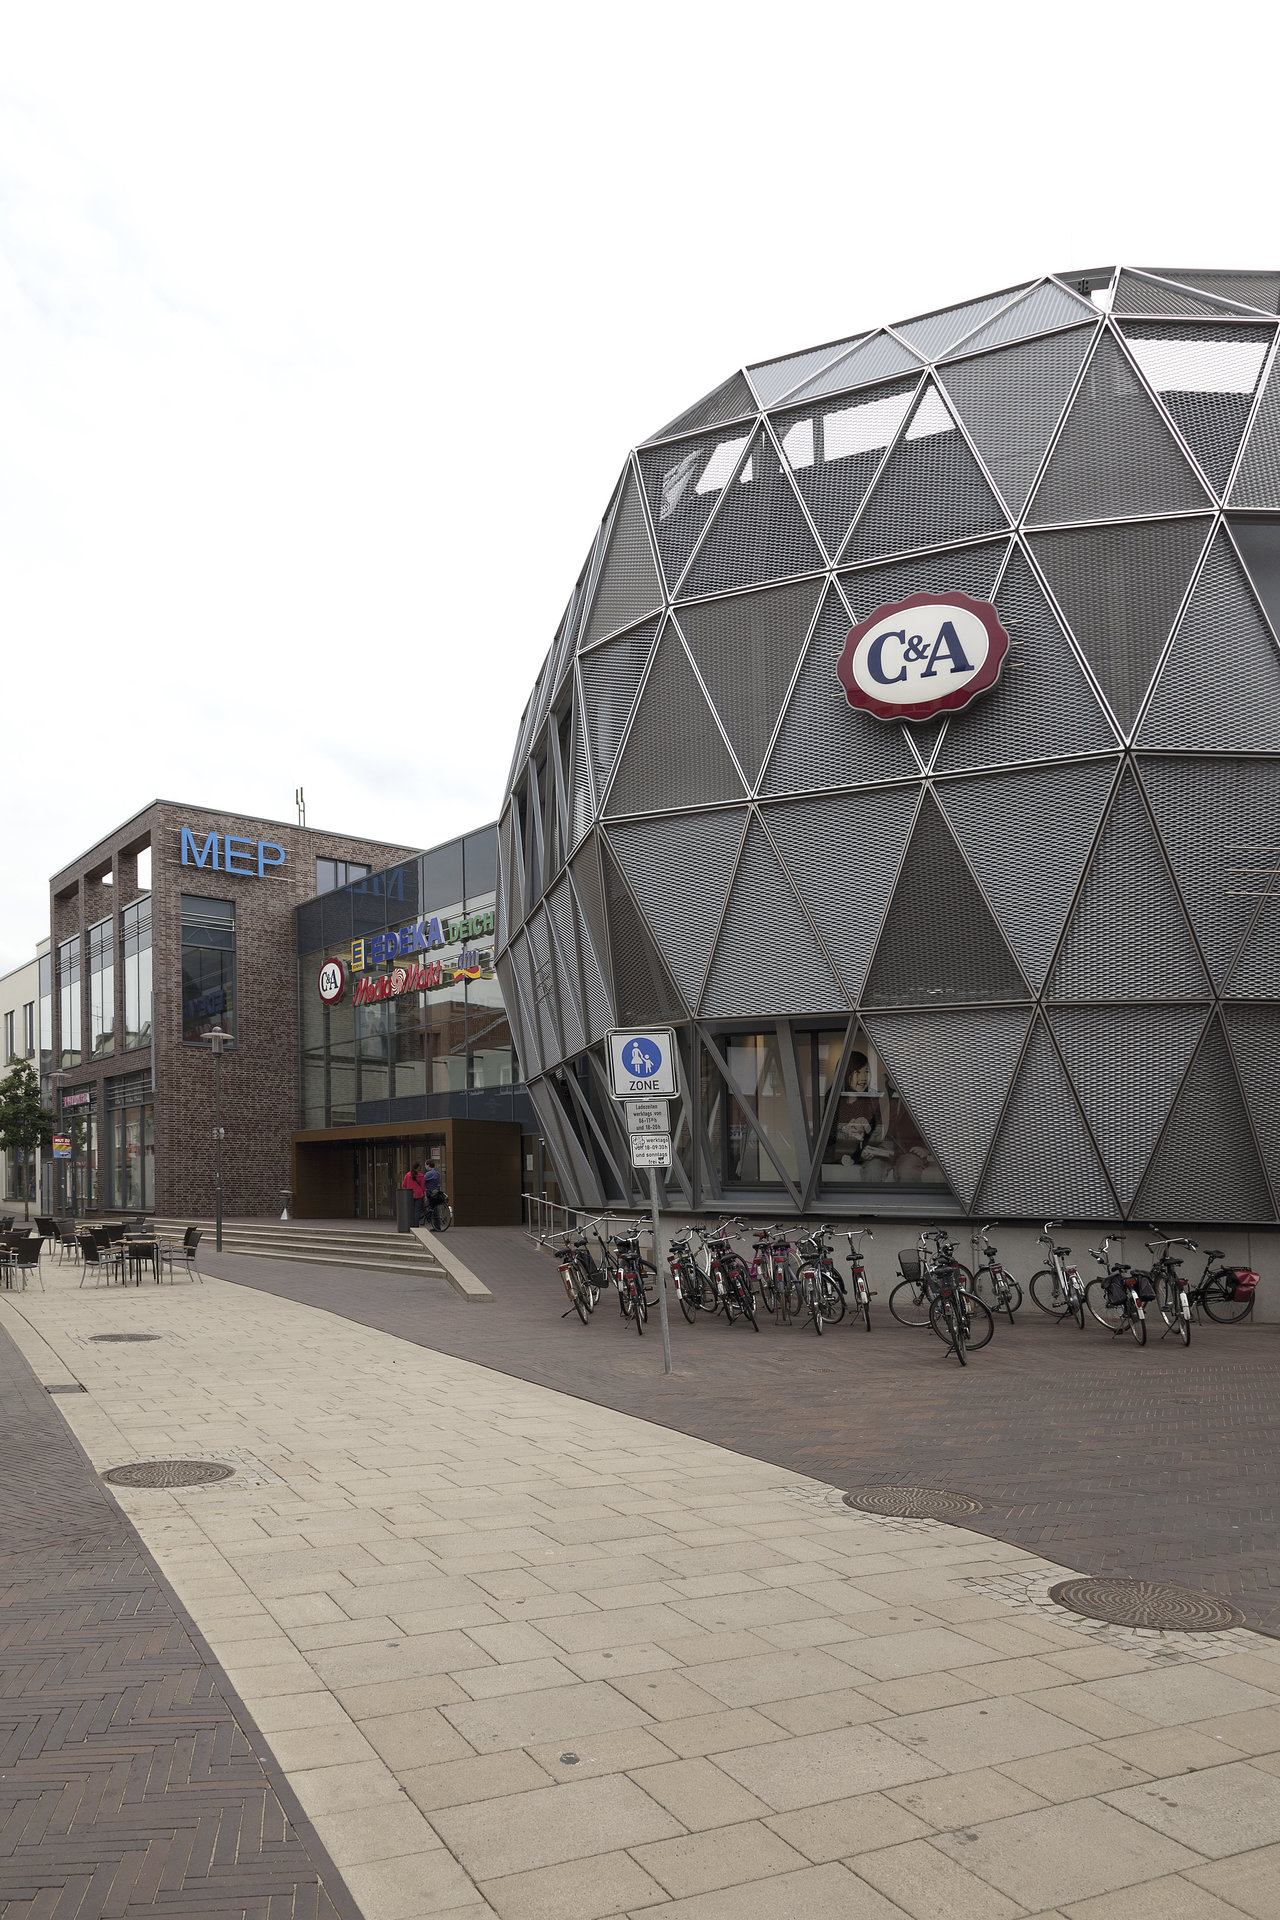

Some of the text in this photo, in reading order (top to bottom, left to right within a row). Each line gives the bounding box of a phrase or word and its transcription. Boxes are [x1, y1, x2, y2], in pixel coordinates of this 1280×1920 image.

[867, 620, 975, 685] C&A
[181, 826, 286, 877] MEP
[371, 917, 443, 964] EDEKA
[449, 911, 495, 942] DEICH
[457, 946, 480, 970] dm
[321, 969, 339, 992] C&A
[629, 1080, 660, 1091] ZONE
